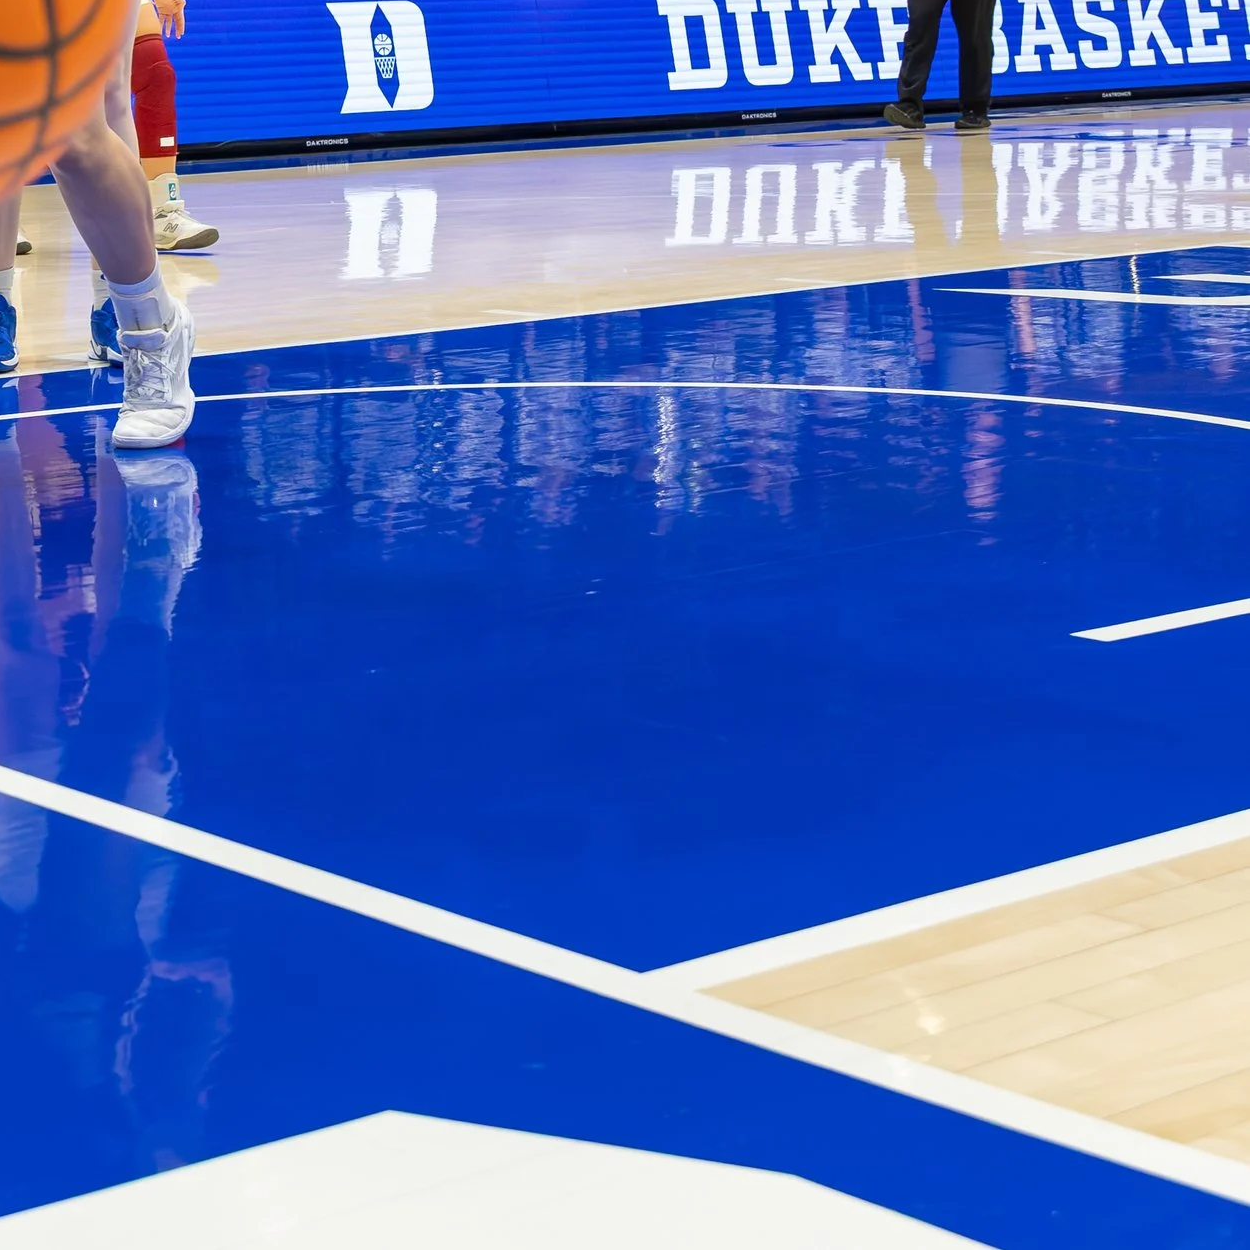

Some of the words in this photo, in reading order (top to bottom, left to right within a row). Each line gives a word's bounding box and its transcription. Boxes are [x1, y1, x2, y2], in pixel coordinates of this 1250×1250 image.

[326, 0, 434, 114] D
[741, 112, 777, 120] DAKTRONICS
[306, 137, 348, 147] DAKTRONICS
